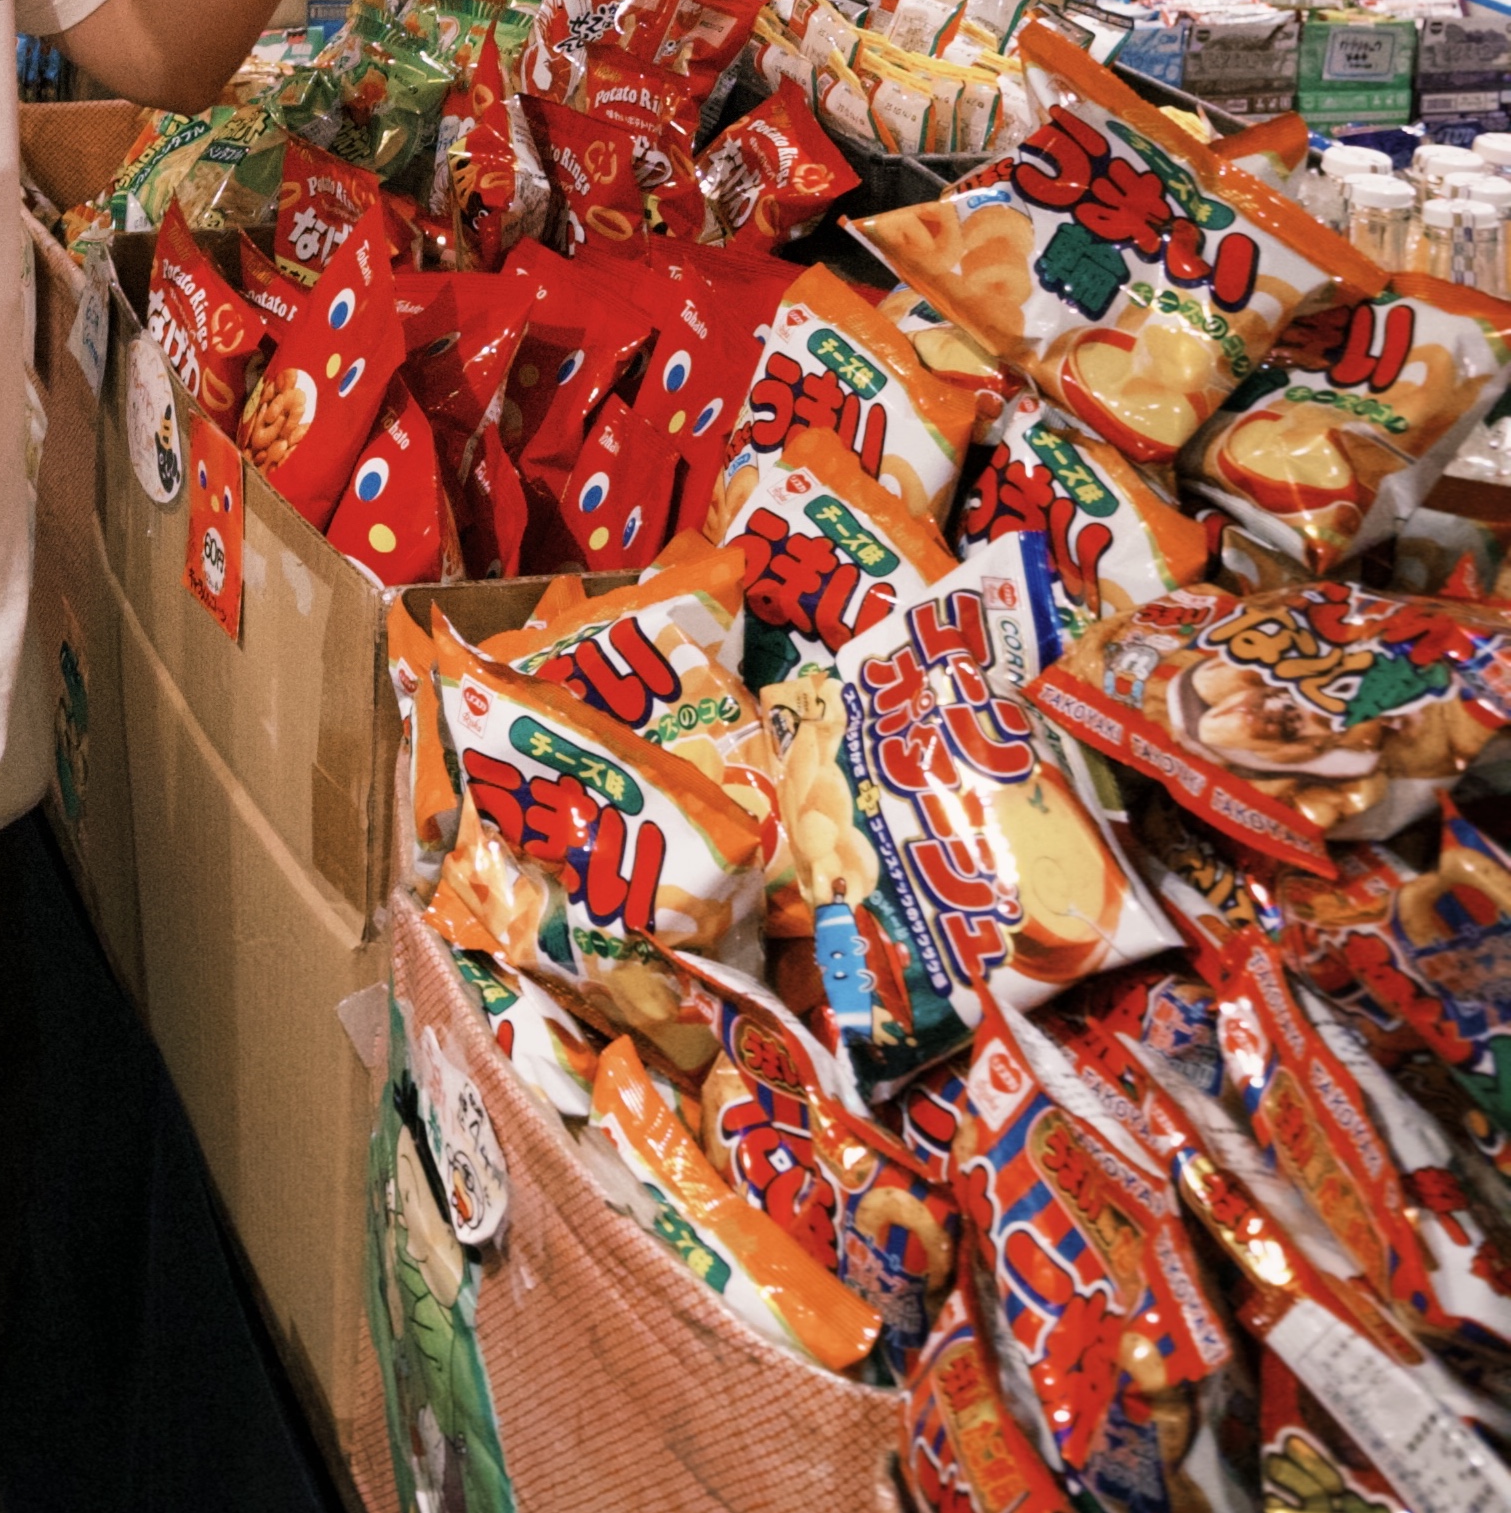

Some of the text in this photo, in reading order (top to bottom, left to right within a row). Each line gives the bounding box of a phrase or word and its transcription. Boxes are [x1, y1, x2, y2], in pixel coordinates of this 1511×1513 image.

[594, 86, 638, 109] Potato
[748, 118, 790, 150] Potato
[559, 146, 591, 197] Rings
[1009, 104, 1260, 314] うまい
[355, 239, 375, 287] Tohato
[162, 258, 210, 352] Potato Rings
[680, 299, 709, 340] Tohato
[821, 336, 876, 391] チーズ味
[382, 407, 411, 451] Tohato
[1032, 430, 1106, 506] チーズ味
[203, 531, 225, 574] 60円
[815, 503, 887, 568] チーズ味
[999, 618, 1027, 690] CORN
[1037, 682, 1125, 746] TAKOYAKI
[529, 730, 628, 803] チーズ味
[463, 747, 667, 935] うまい
